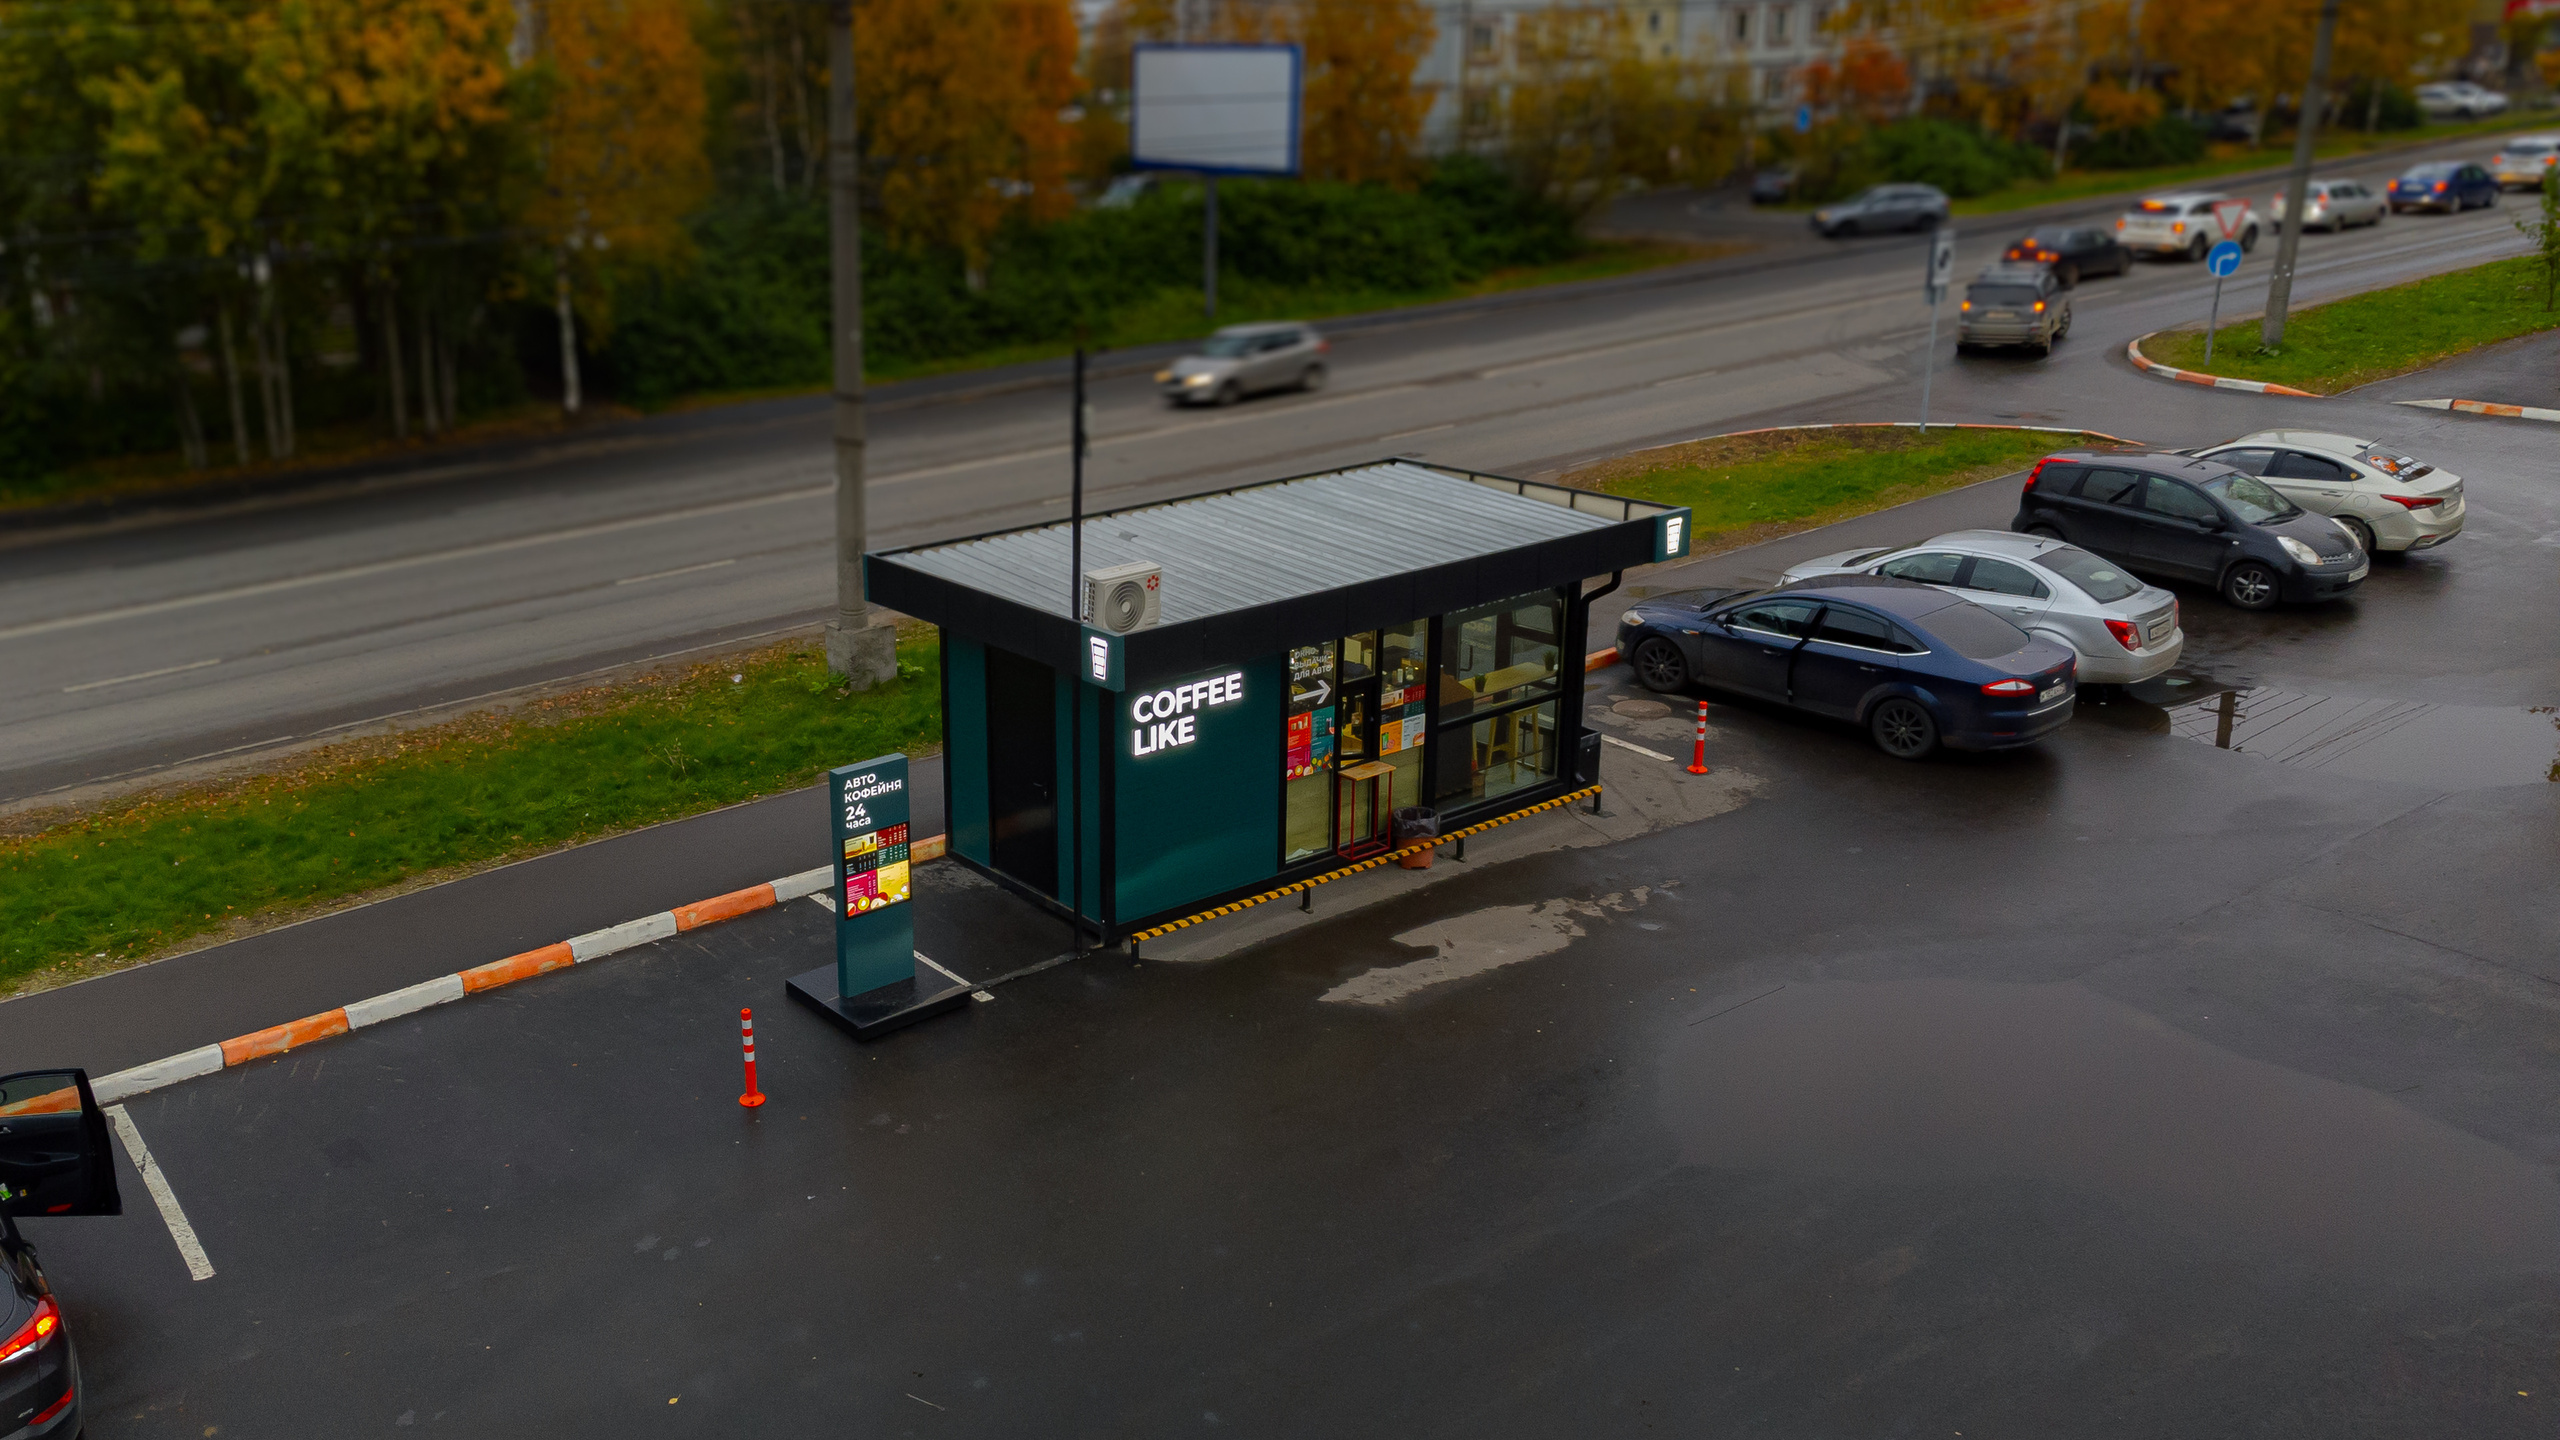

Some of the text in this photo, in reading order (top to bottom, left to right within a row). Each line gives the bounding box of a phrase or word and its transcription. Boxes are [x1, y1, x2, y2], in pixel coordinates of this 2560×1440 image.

[1294, 647, 1317, 659] ОКНО
[1294, 654, 1328, 670] ВЫДАЧИ
[1293, 664, 1332, 682] ДЛЯ АВТО
[1133, 672, 1242, 723] COFFEE
[1134, 715, 1195, 756] LIKE
[844, 773, 876, 790] АВТО
[844, 779, 902, 803] КОФЕЙНЯ
[845, 803, 866, 820] 24
[846, 816, 871, 829] часа
